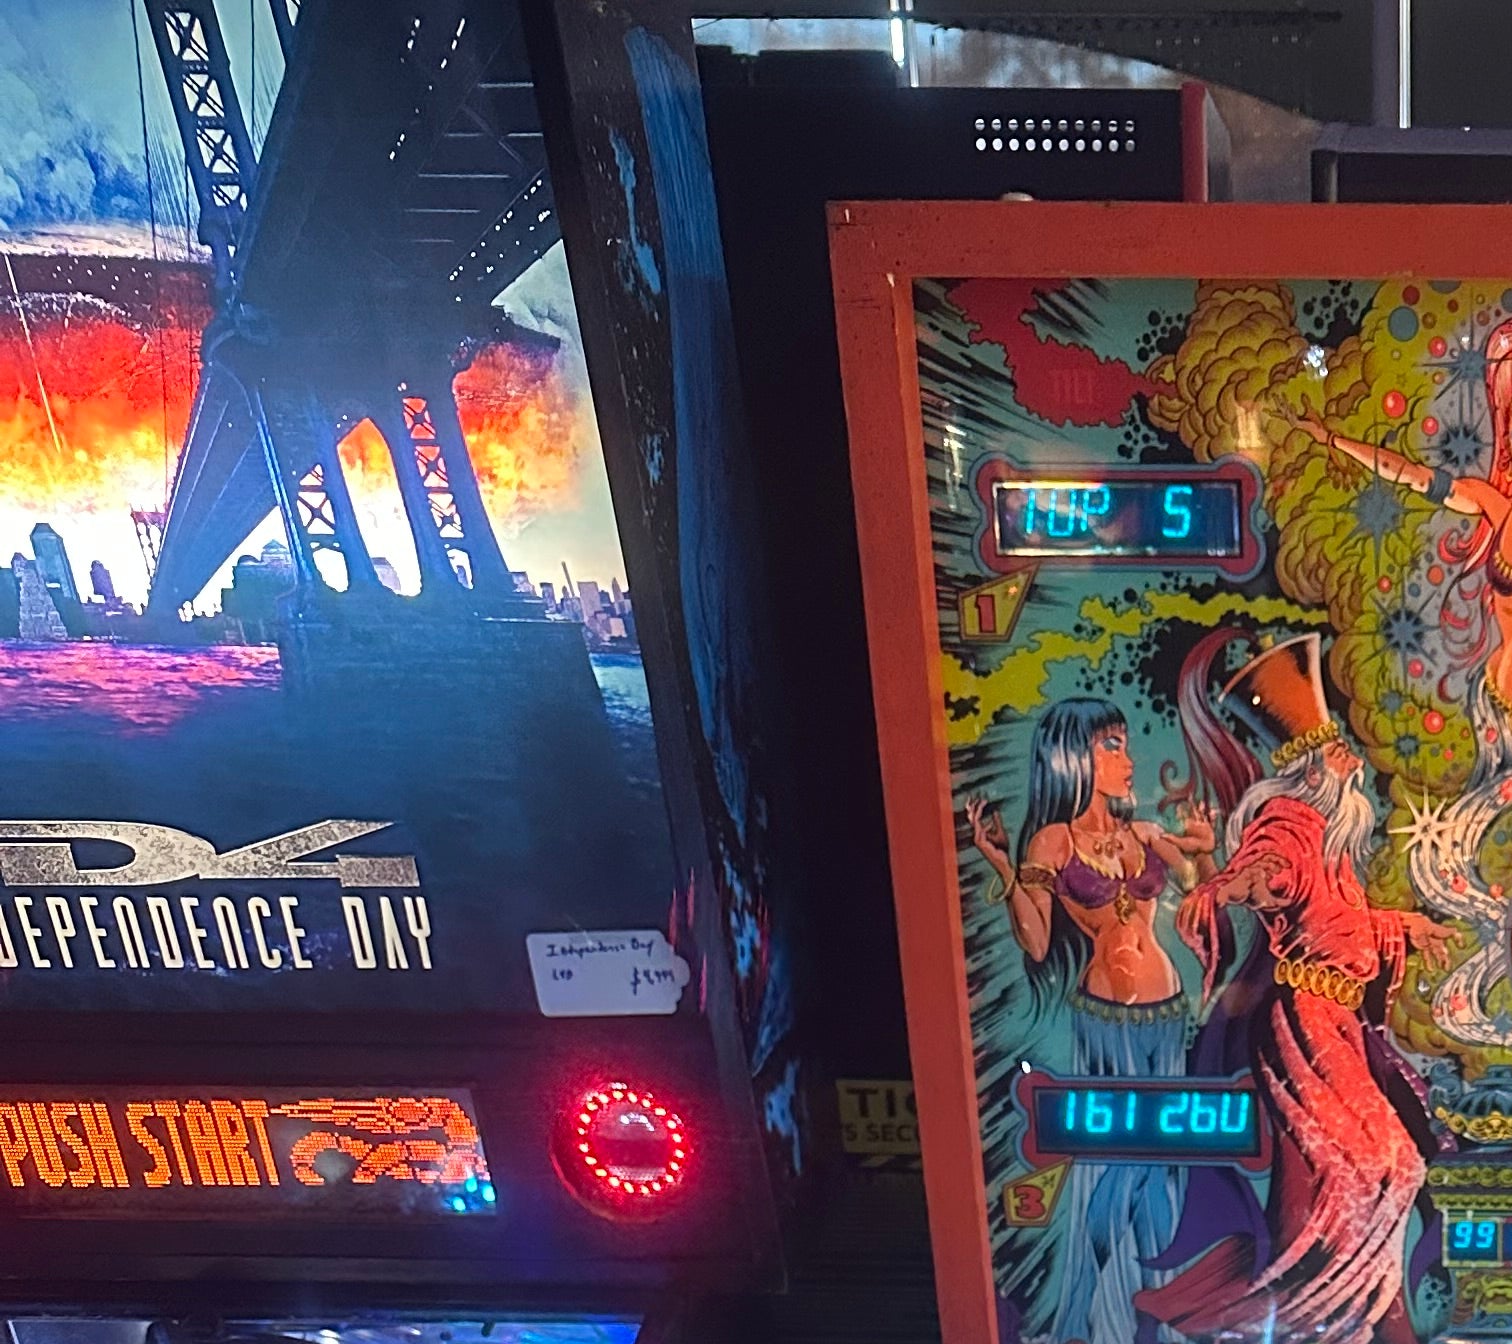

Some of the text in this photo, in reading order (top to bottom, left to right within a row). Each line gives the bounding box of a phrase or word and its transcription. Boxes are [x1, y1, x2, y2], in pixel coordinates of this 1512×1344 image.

[975, 593, 997, 635] 1
[0, 896, 433, 970] DEPENDENCE DAY
[0, 1100, 281, 1188] PUSH START
[1013, 1184, 1046, 1219] 3
[1453, 1220, 1496, 1249] 99
